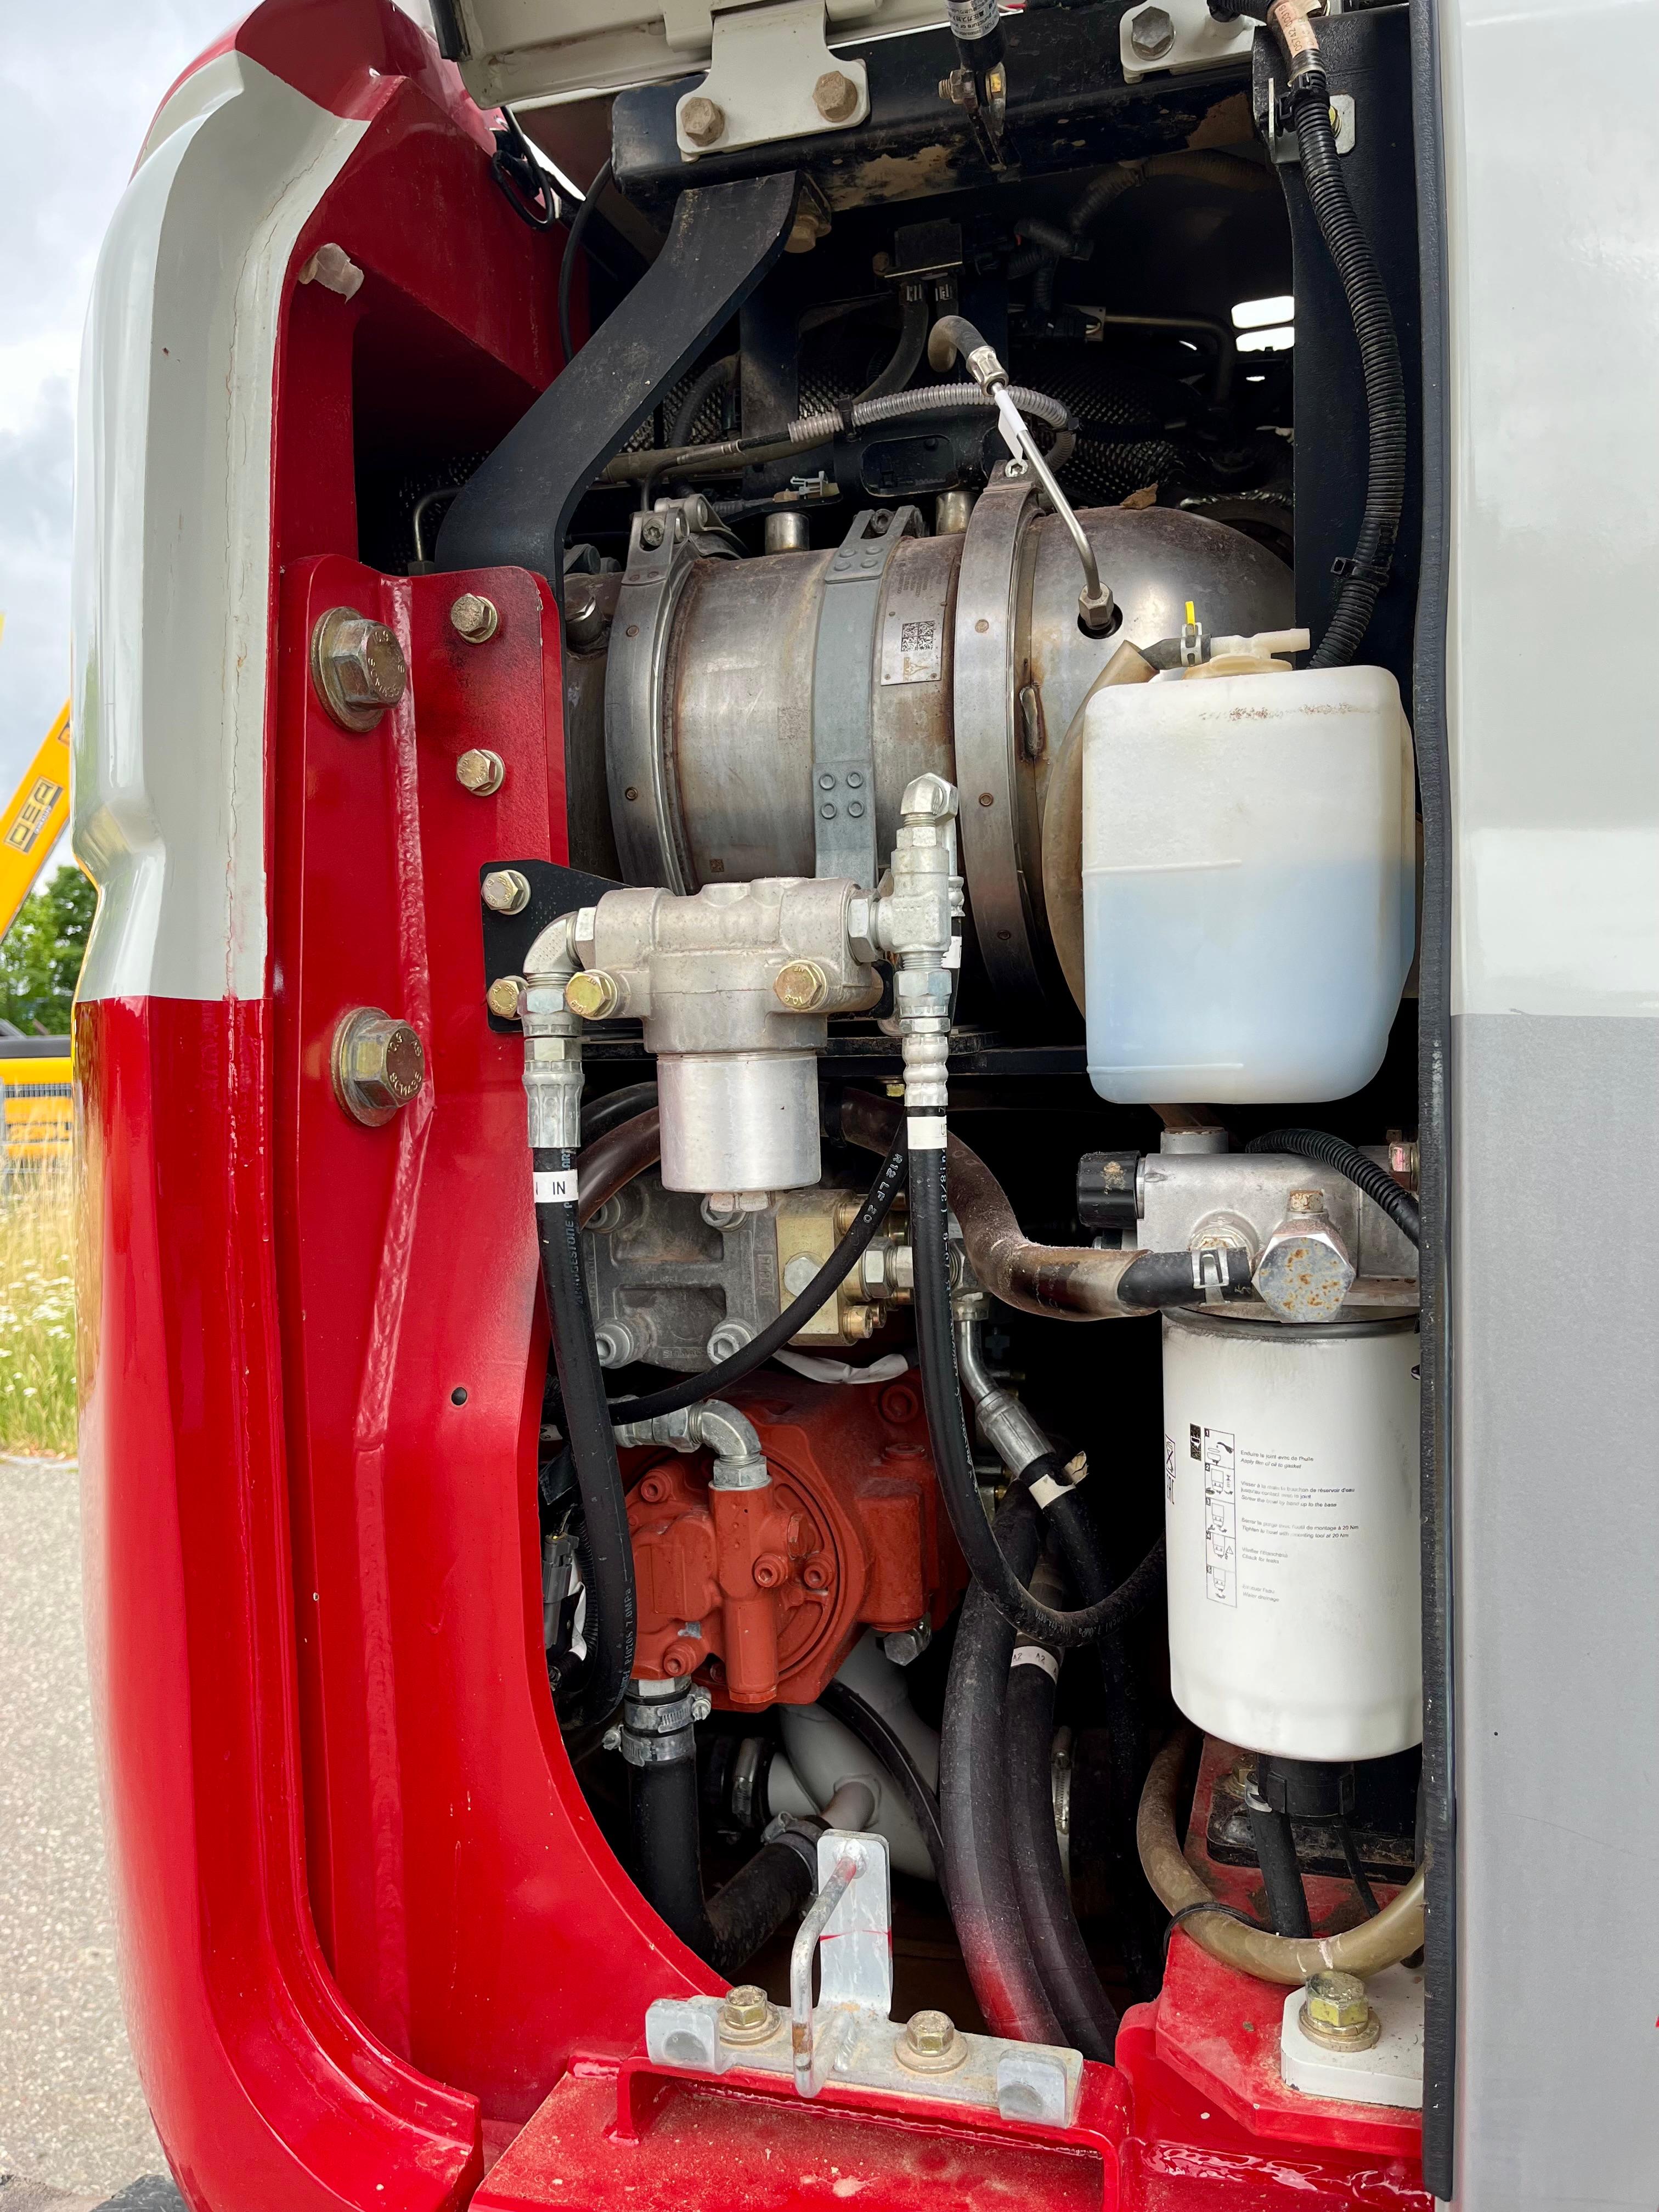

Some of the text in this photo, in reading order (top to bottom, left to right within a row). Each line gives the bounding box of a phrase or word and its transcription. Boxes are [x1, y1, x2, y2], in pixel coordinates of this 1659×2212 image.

[553, 1181, 566, 1195] IN
[863, 1153, 904, 1223] R12 LF 20
[1035, 1652, 1045, 1664] A2
